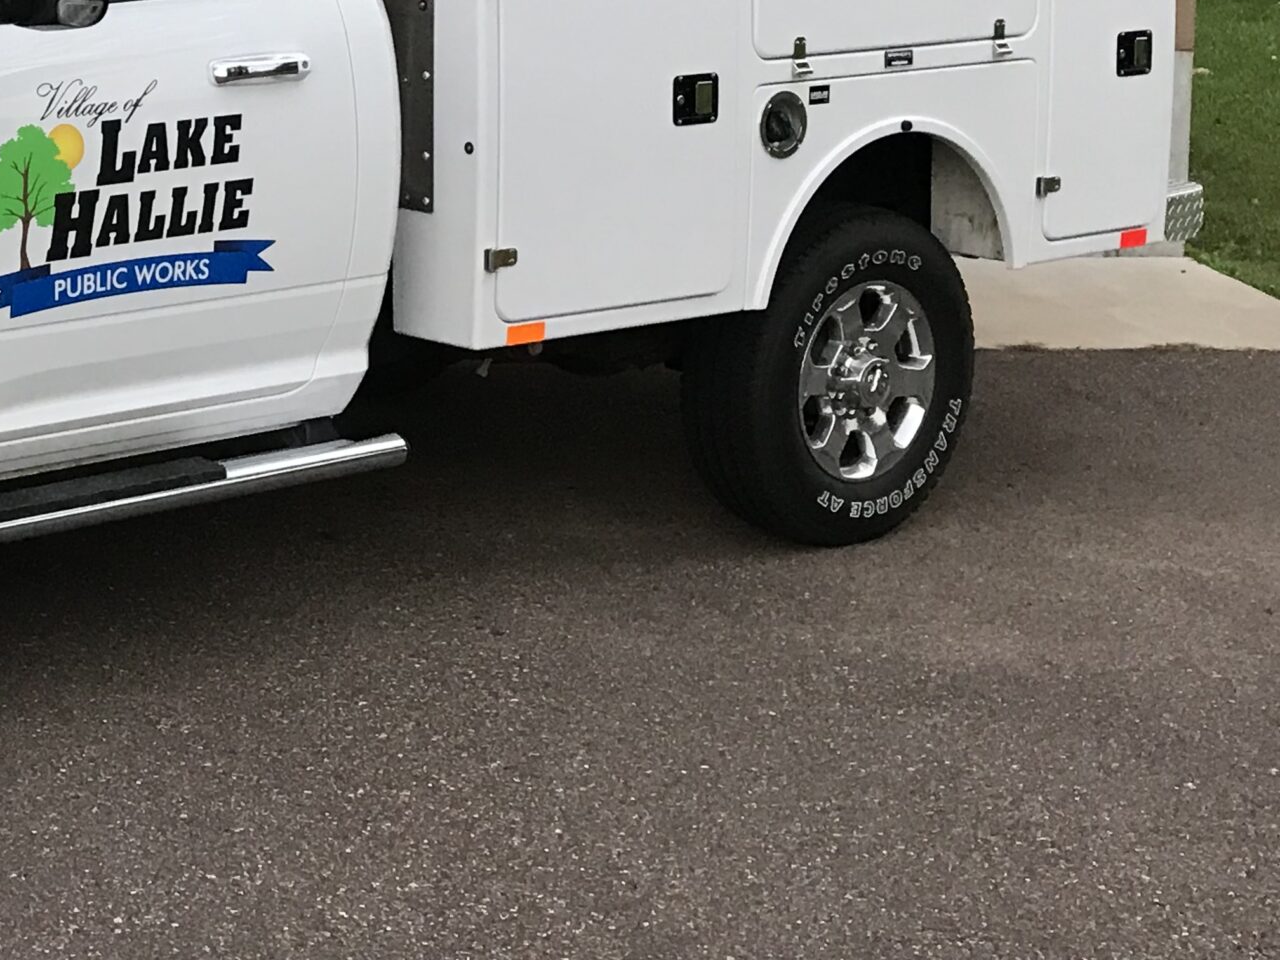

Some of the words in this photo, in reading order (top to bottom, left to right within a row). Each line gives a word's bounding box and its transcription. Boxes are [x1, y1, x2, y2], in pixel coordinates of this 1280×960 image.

[36, 79, 118, 128] Village
[123, 79, 158, 123] of
[96, 114, 242, 186] LAKE
[45, 178, 254, 263] HALLIE
[54, 267, 128, 301] PUBLIC
[135, 259, 210, 286] WORKS
[794, 250, 922, 348] Firestone
[850, 398, 962, 518] TRANSFORCE
[817, 490, 844, 513] AT
